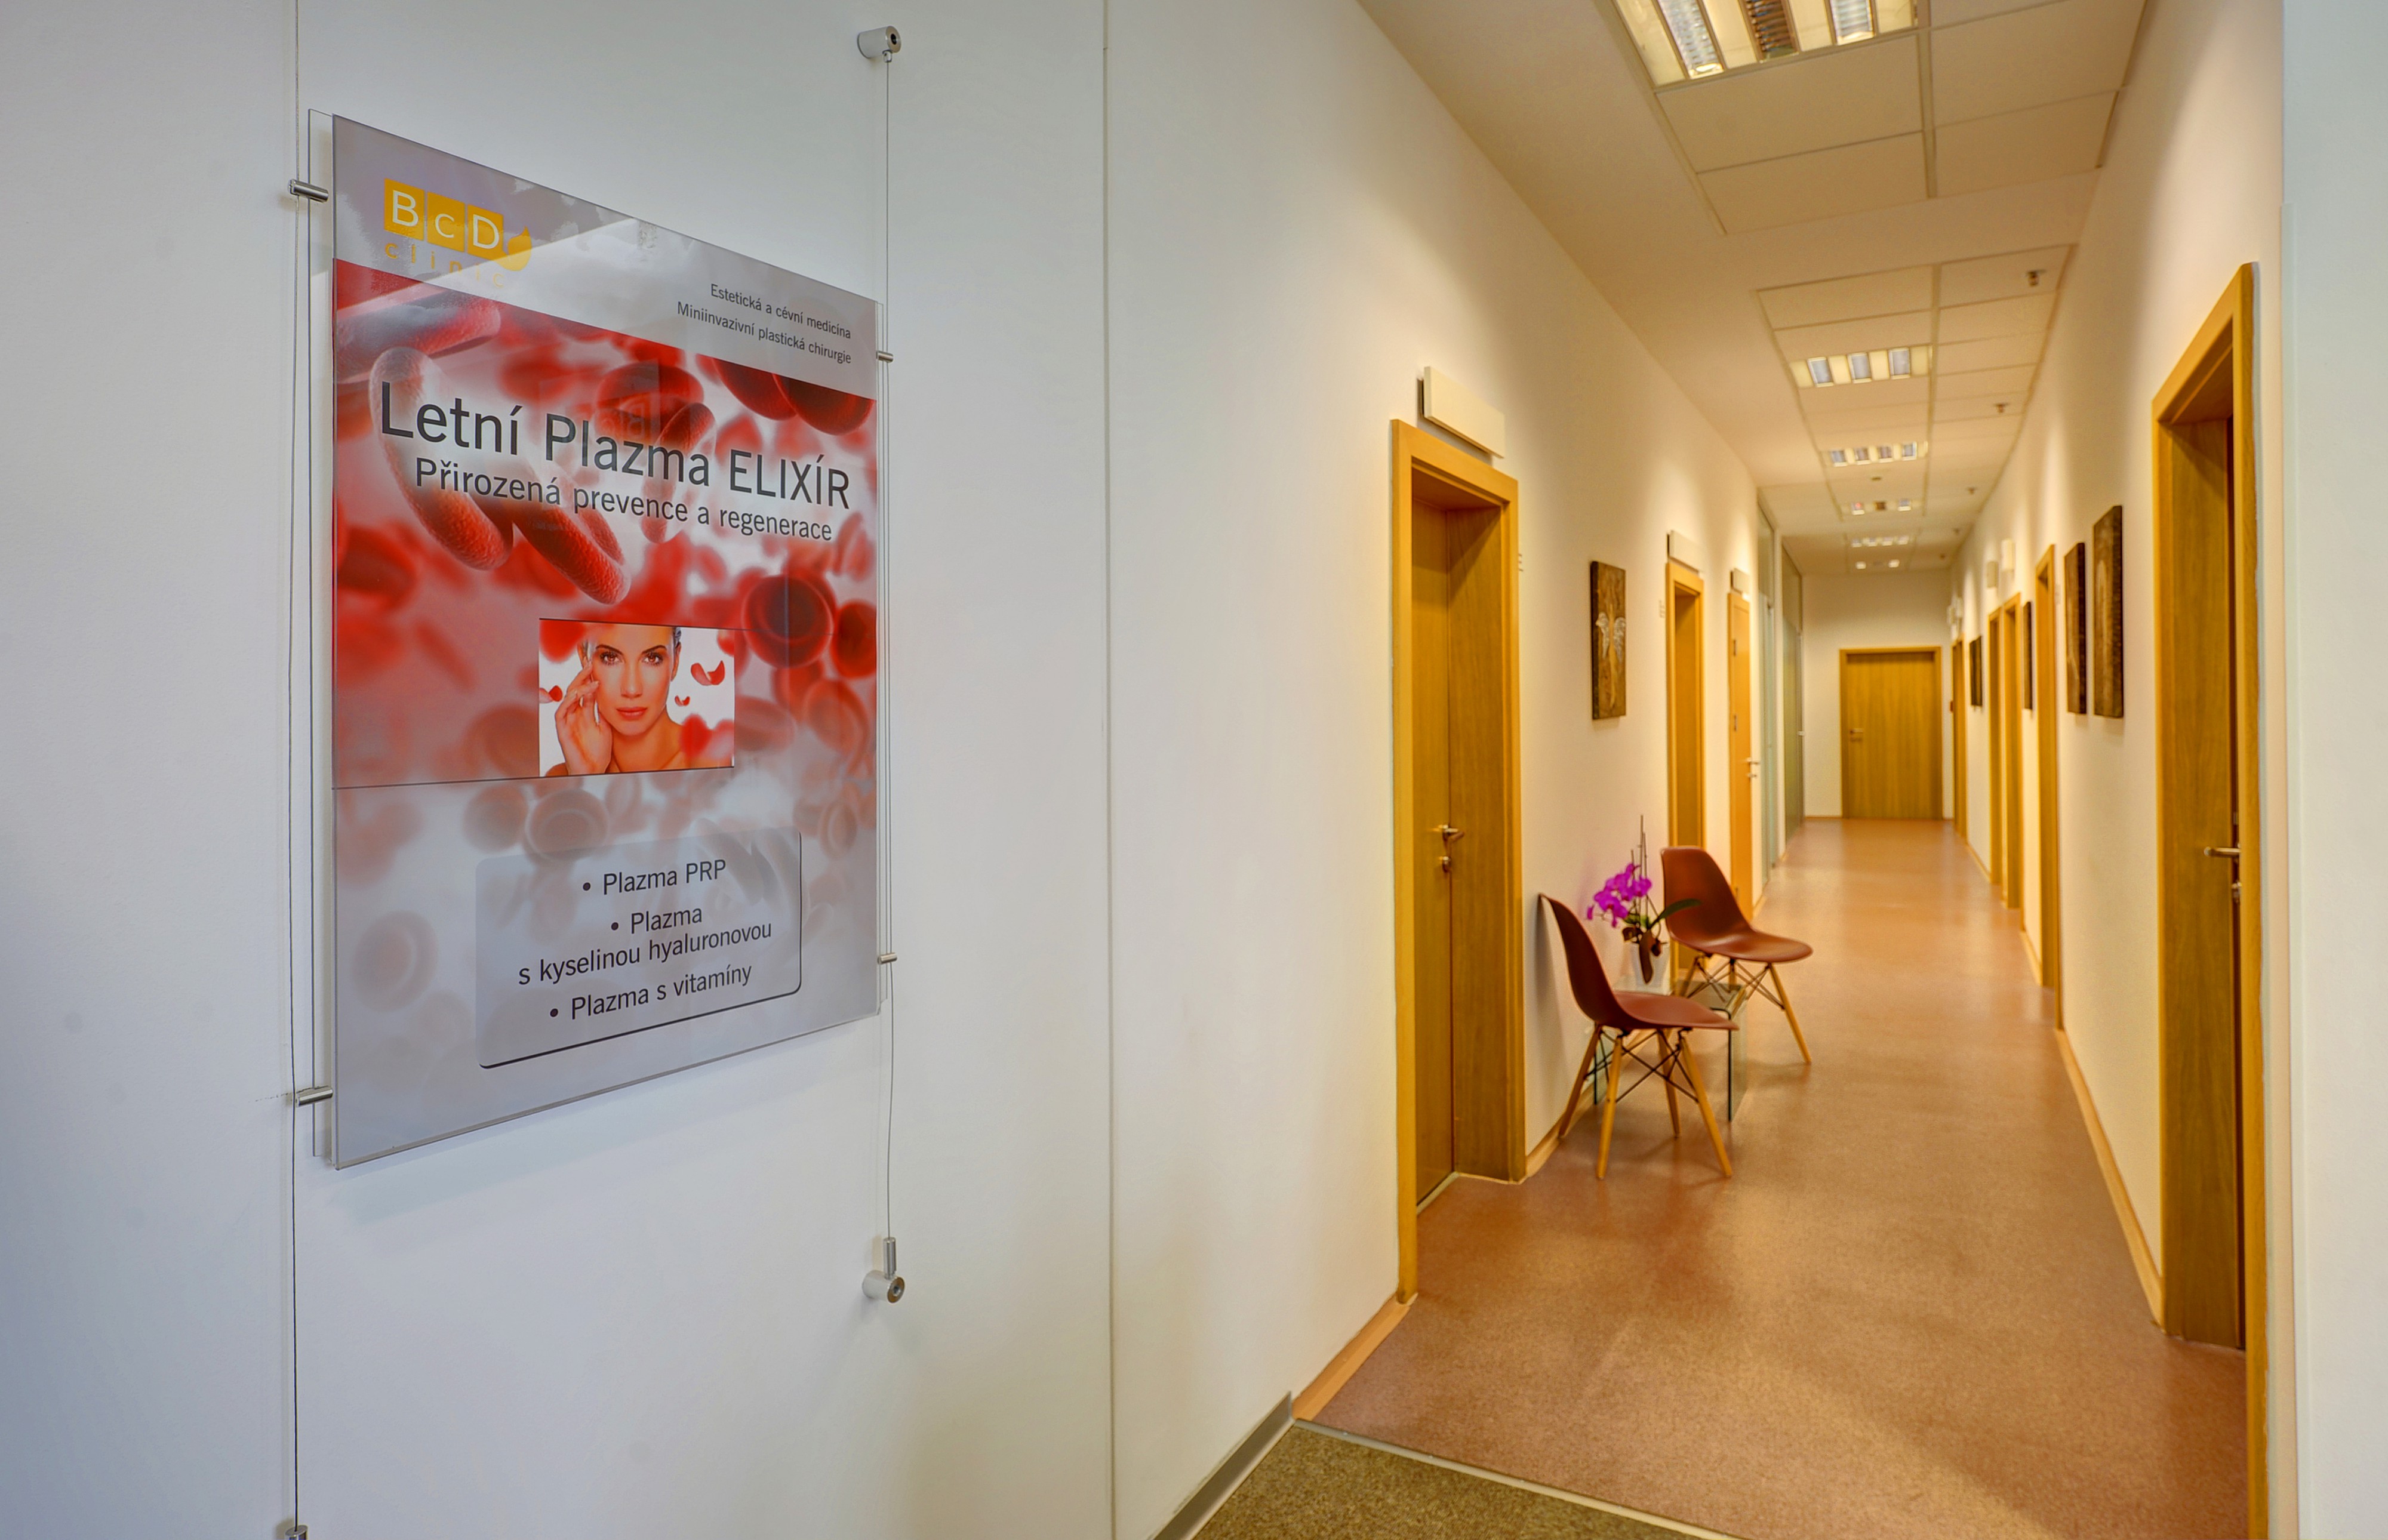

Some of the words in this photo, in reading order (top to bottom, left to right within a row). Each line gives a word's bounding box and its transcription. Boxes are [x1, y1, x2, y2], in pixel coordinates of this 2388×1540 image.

[392, 190, 500, 250] BcD
[384, 242, 504, 288] clinic
[677, 301, 755, 335] Miniinvazivní
[758, 327, 805, 350] plastická
[808, 342, 851, 364] chirurgie
[710, 284, 762, 310] Estetická
[765, 305, 772, 313] a
[776, 306, 803, 324] cévní
[807, 317, 851, 339] medicína
[380, 381, 523, 455] Letní
[544, 414, 710, 487] Plazma
[730, 449, 850, 509] ELIXÍR
[416, 457, 560, 506] Přirozená
[574, 488, 688, 522] prevence
[697, 506, 710, 525] a
[719, 509, 832, 541] regenerace
[603, 870, 677, 895] Plazma
[685, 859, 726, 883] PRP
[630, 907, 702, 934] Plazma
[519, 967, 530, 985] s
[540, 946, 640, 984] kyselinou
[650, 922, 771, 963] hyaluronovou
[571, 988, 648, 1020] Plazma
[657, 984, 666, 1000] s
[673, 964, 752, 996] vitamíny
